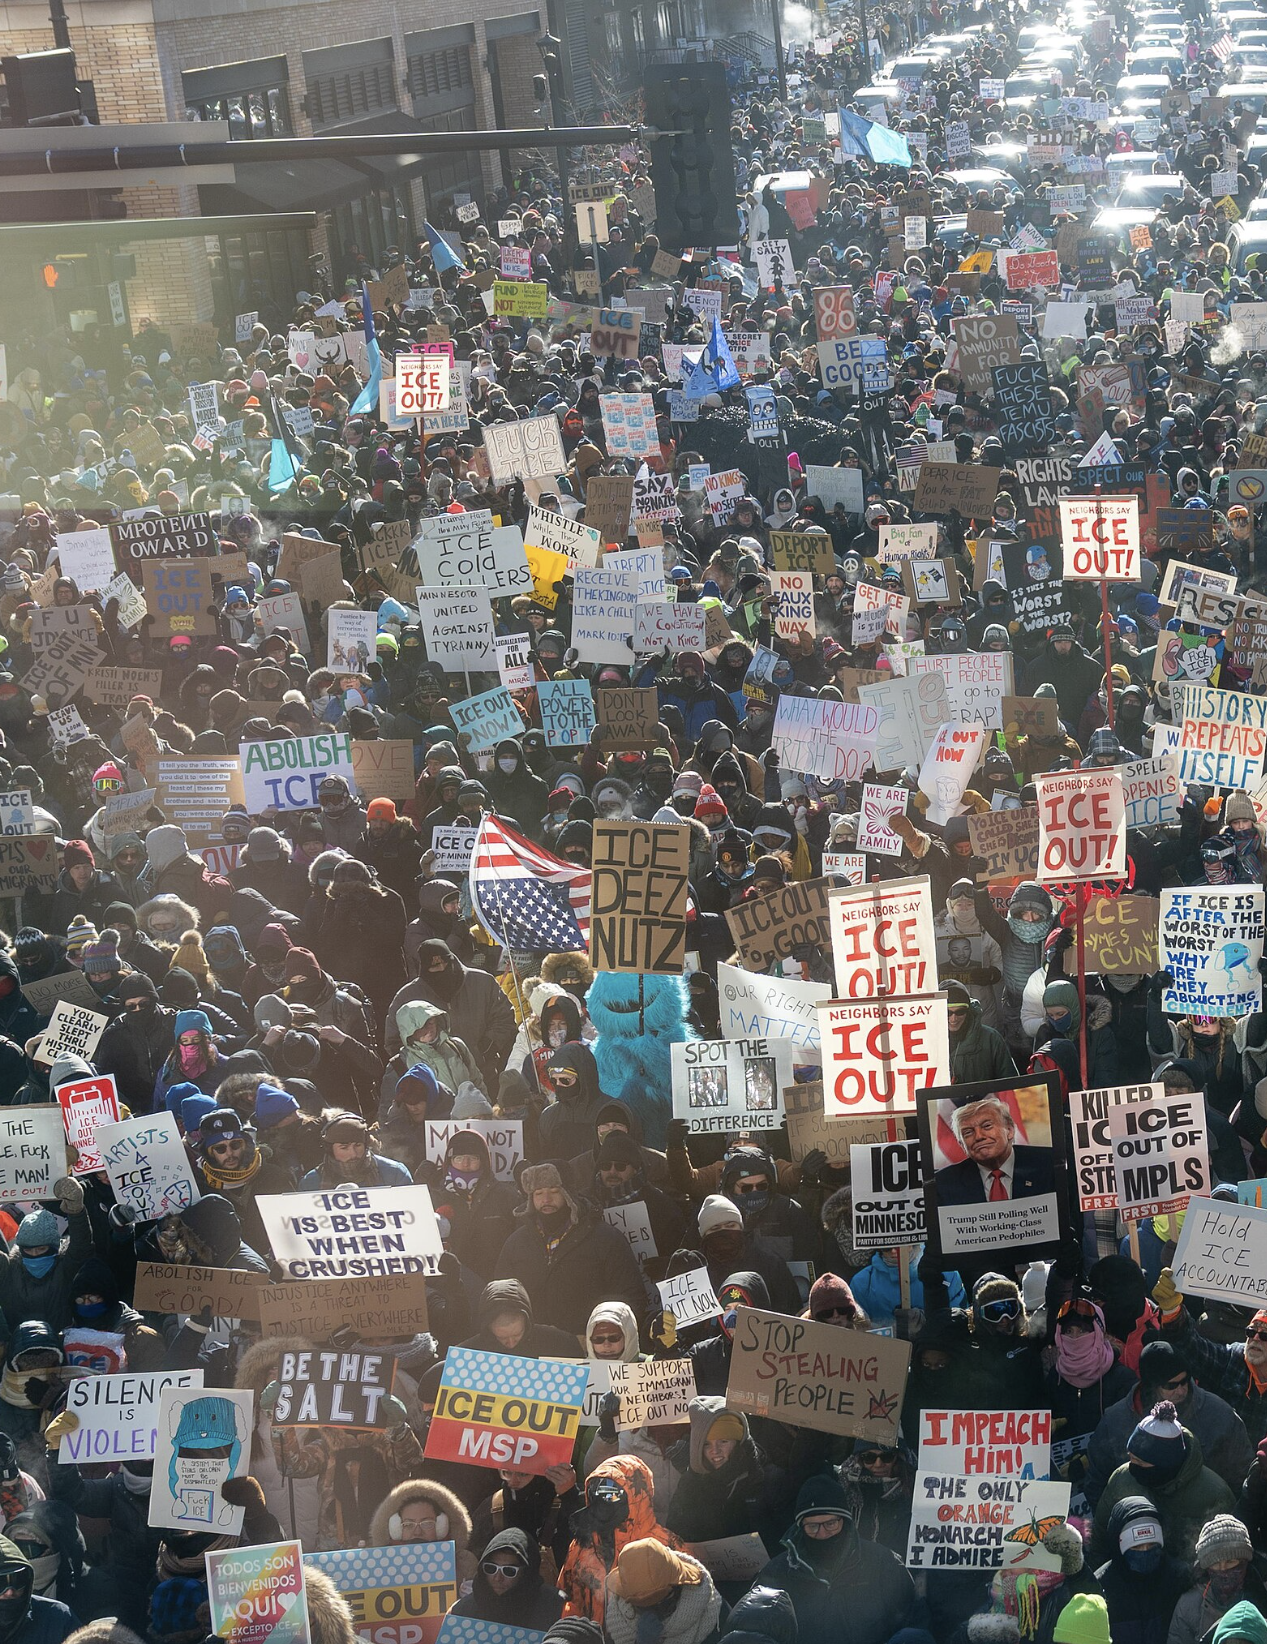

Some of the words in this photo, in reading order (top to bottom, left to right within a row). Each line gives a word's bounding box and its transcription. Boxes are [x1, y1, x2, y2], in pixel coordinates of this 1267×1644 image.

[757, 245, 786, 254] SALTY
[960, 321, 997, 340] NO
[960, 336, 1018, 356] IMMUNITY
[978, 352, 1010, 369] FOR
[402, 372, 440, 390] ICE
[996, 365, 1045, 384] FUCK
[401, 392, 443, 410] OUT!
[998, 384, 1050, 403] THESE
[1002, 403, 1050, 421] TEMU
[1000, 419, 1054, 442] FASCISTS
[1069, 506, 1113, 514] NEIGHBORS
[1072, 517, 1129, 544] ICE
[772, 534, 828, 553] DEPORT
[786, 554, 817, 571] ICE
[1073, 548, 1134, 577] OUT!
[780, 577, 803, 589] NO
[433, 604, 478, 617] UNITED
[432, 623, 488, 636] AGAINST
[779, 622, 808, 633] WAY
[1185, 688, 1267, 728] HISTORY
[1182, 720, 1266, 756] REPEATS
[244, 734, 352, 774] ABOLISH
[1180, 750, 1258, 788] ITSELF
[1042, 780, 1093, 794] NEIGHBORS
[1096, 778, 1113, 788] SAY
[1045, 794, 1112, 831] ICE
[596, 829, 680, 866] ICE
[1043, 833, 1117, 870] OUT!
[594, 870, 685, 917] DEEZ
[592, 917, 685, 972] NUTZ
[685, 1041, 730, 1064] SPOT
[735, 1040, 768, 1057] THE
[692, 1116, 774, 1131] DIFFERENCE
[1126, 1104, 1193, 1134] ICE
[1117, 1135, 1167, 1158] OUT
[1171, 1131, 1203, 1147] OF
[1123, 1157, 1203, 1202] MPLS
[321, 1191, 371, 1211] ICE
[292, 1218, 318, 1234] IS
[328, 1211, 404, 1232] BEST
[948, 1215, 977, 1226] Trump
[979, 1213, 996, 1222] Still
[998, 1209, 1028, 1221] Polling
[1029, 1205, 1048, 1215] Well
[956, 1225, 977, 1235] With
[979, 1217, 1042, 1233] Working-Class
[307, 1234, 405, 1256] WHEN
[954, 1235, 997, 1247] American
[998, 1229, 1045, 1242] Pedophiles
[288, 1253, 438, 1278] CRUSHED!
[741, 1316, 804, 1353] STOP
[282, 1353, 311, 1382] BE
[317, 1353, 382, 1383] THE
[756, 1352, 878, 1383] STEALING
[276, 1384, 386, 1424] SALT
[773, 1379, 855, 1415] PEOPLE
[436, 1389, 494, 1422] ICE
[502, 1399, 577, 1435] OUT
[923, 1413, 1050, 1446] IMPEACH
[458, 1428, 538, 1465] MSP
[215, 1559, 261, 1578] TODOS
[264, 1554, 295, 1570] SON
[218, 1576, 296, 1596] BIENVENIDOS
[222, 1590, 278, 1622] AQUÍ
[231, 1624, 273, 1637] EXCEPTO
